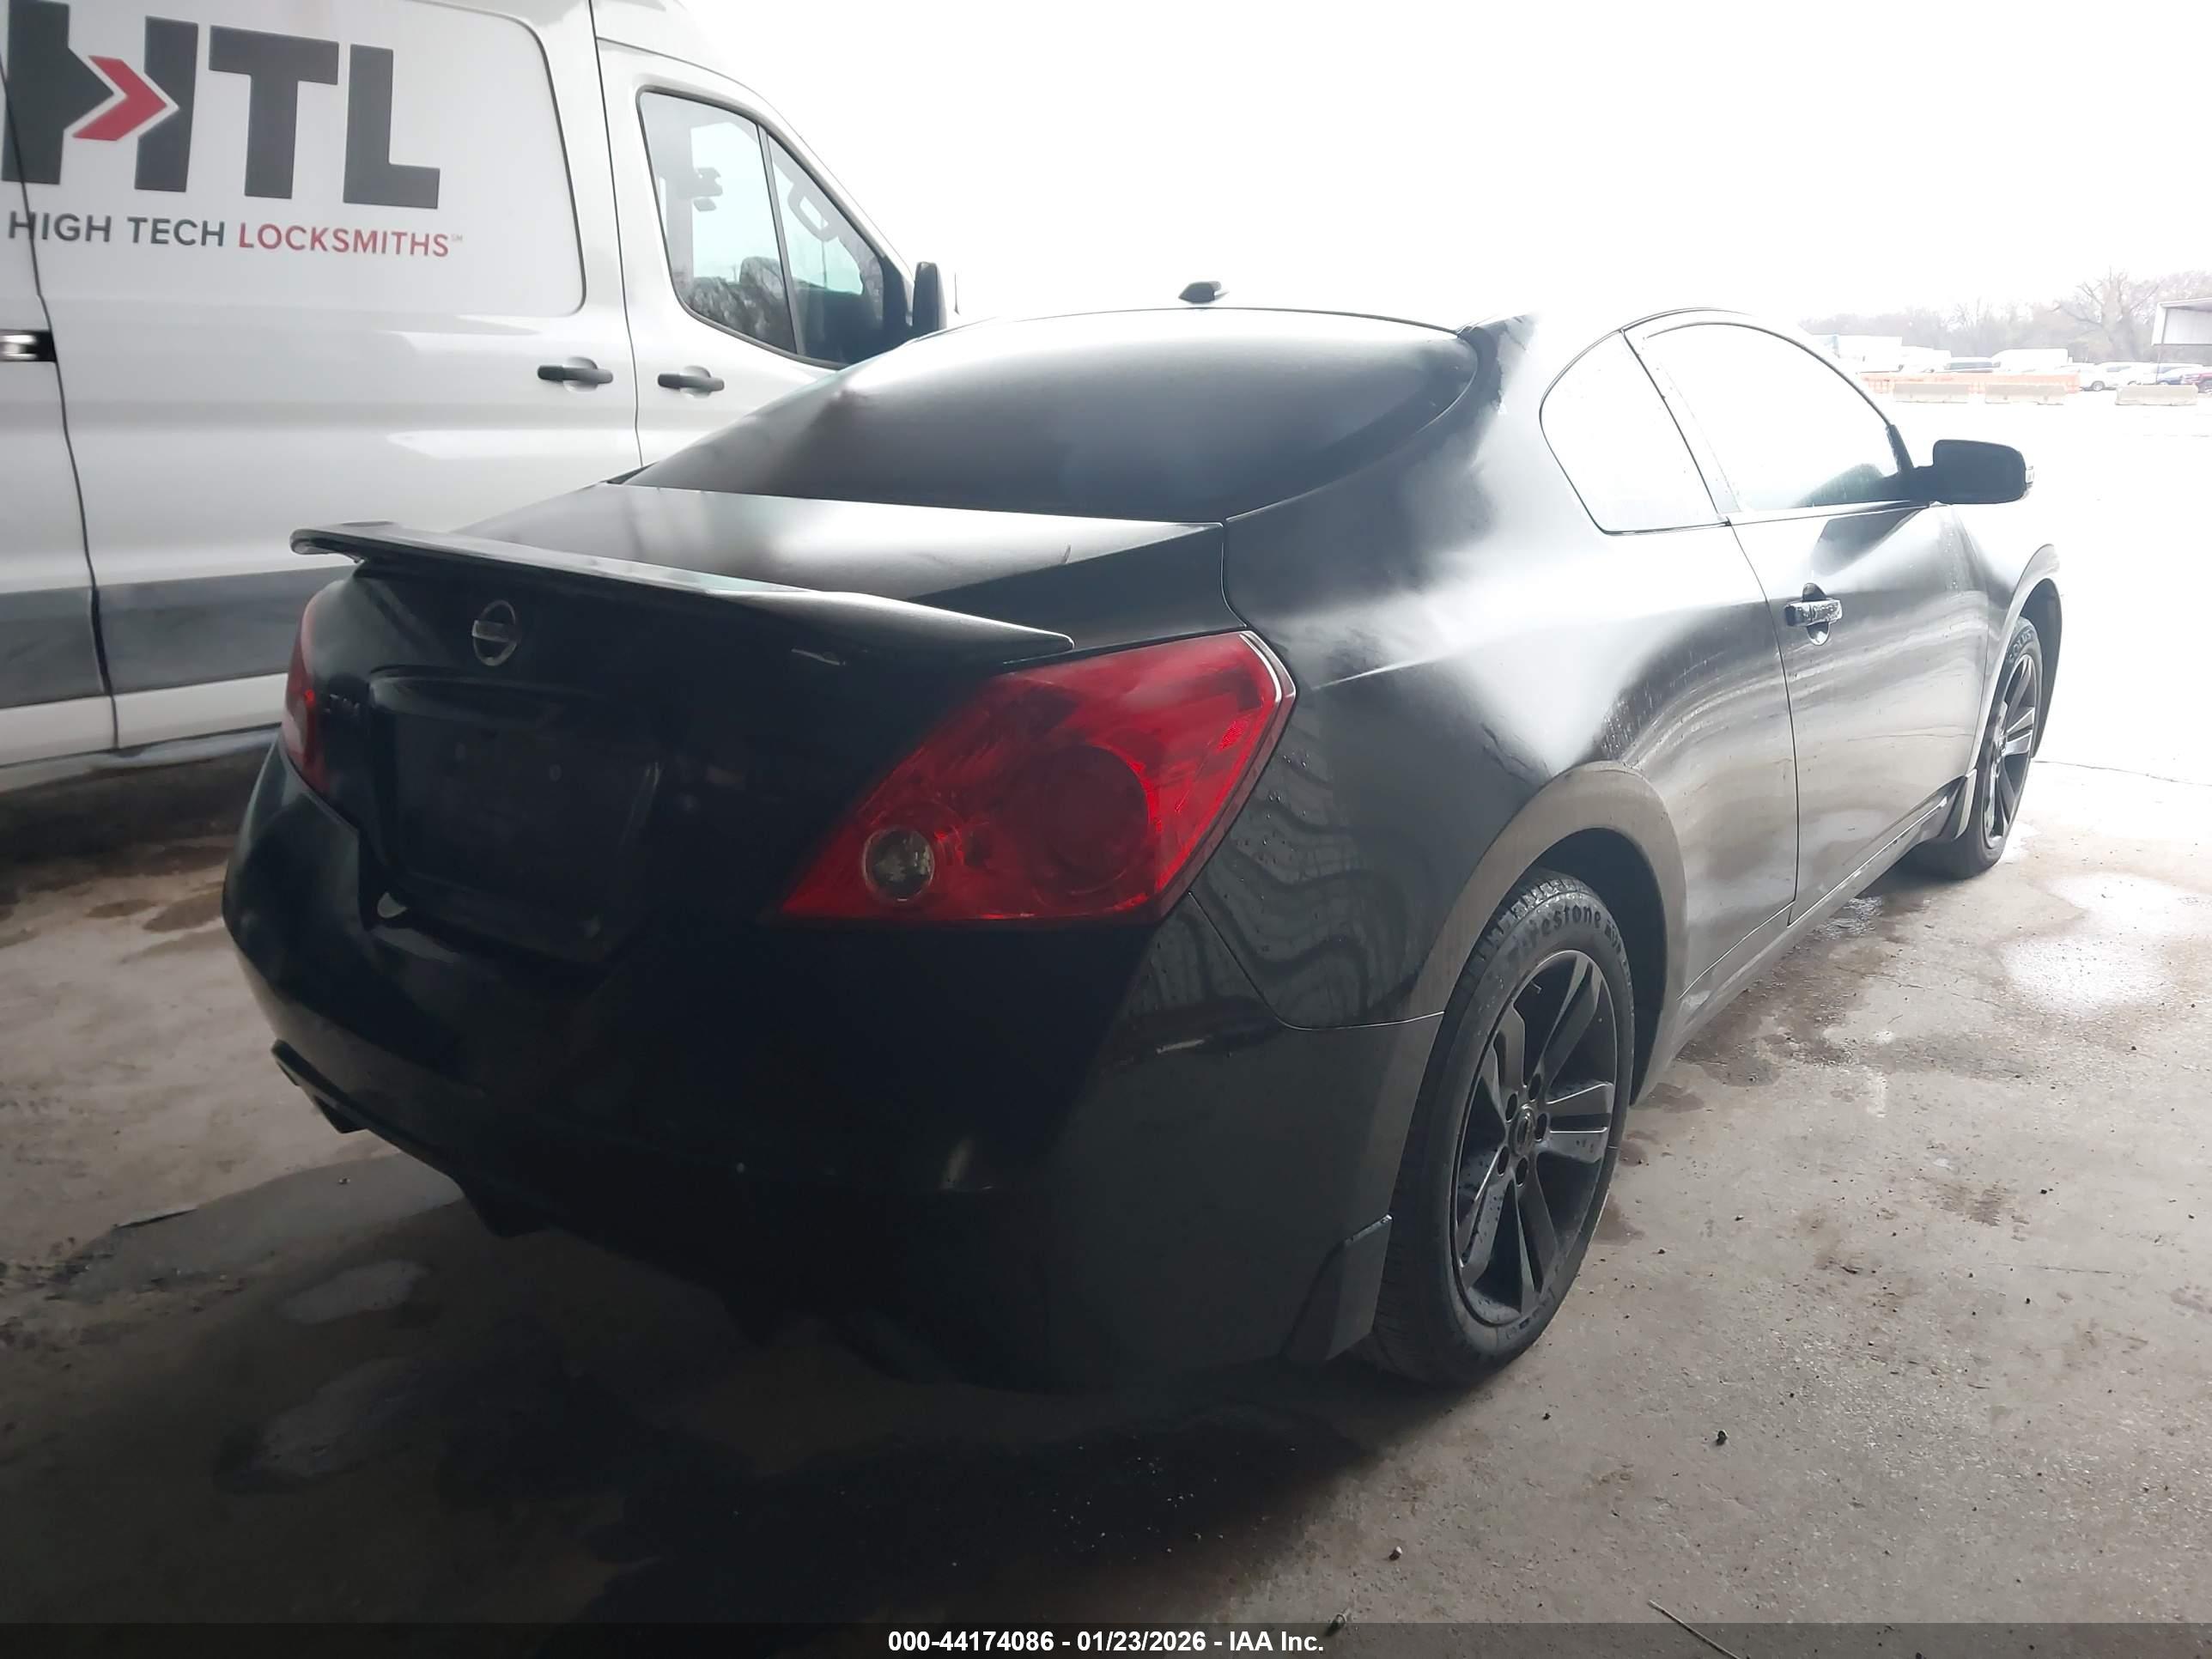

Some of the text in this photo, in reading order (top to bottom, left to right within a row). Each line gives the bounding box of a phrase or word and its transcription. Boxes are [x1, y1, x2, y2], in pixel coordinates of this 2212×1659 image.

[2, 0, 441, 210] HTL
[9, 210, 111, 243] HIGH
[127, 216, 225, 247] TECH
[238, 222, 449, 257] LOCKSMITHS
